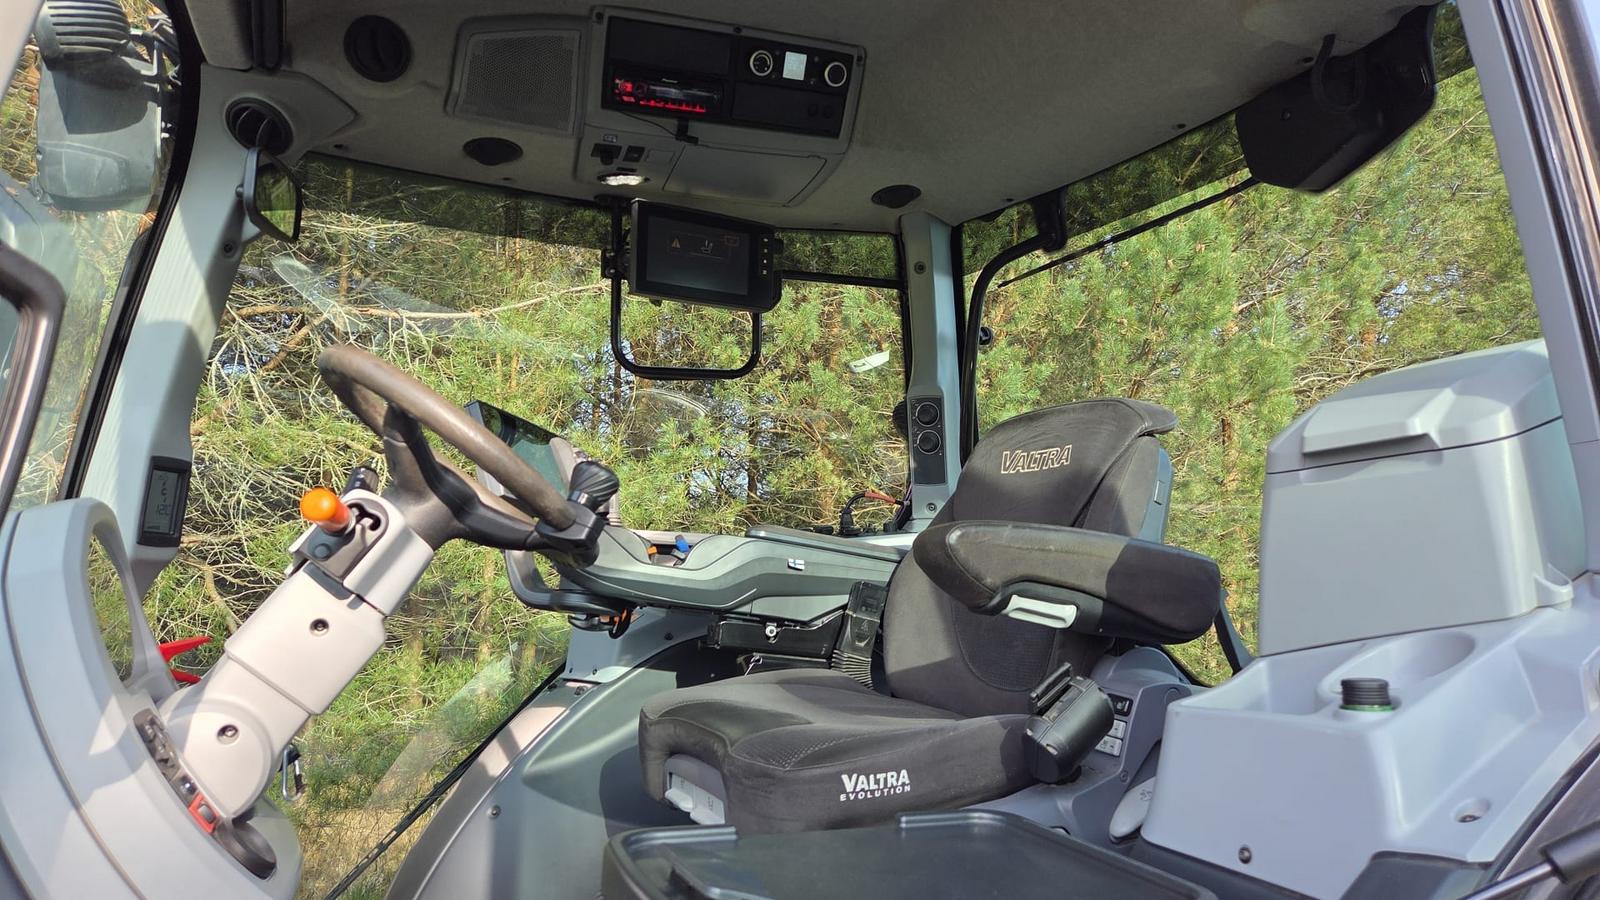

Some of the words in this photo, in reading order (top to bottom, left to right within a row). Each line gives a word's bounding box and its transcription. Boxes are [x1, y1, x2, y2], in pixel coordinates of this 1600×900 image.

[1000, 444, 1073, 474] VALTRA
[840, 785, 911, 801] EVOLUTION
[841, 769, 910, 793] VALTRA
